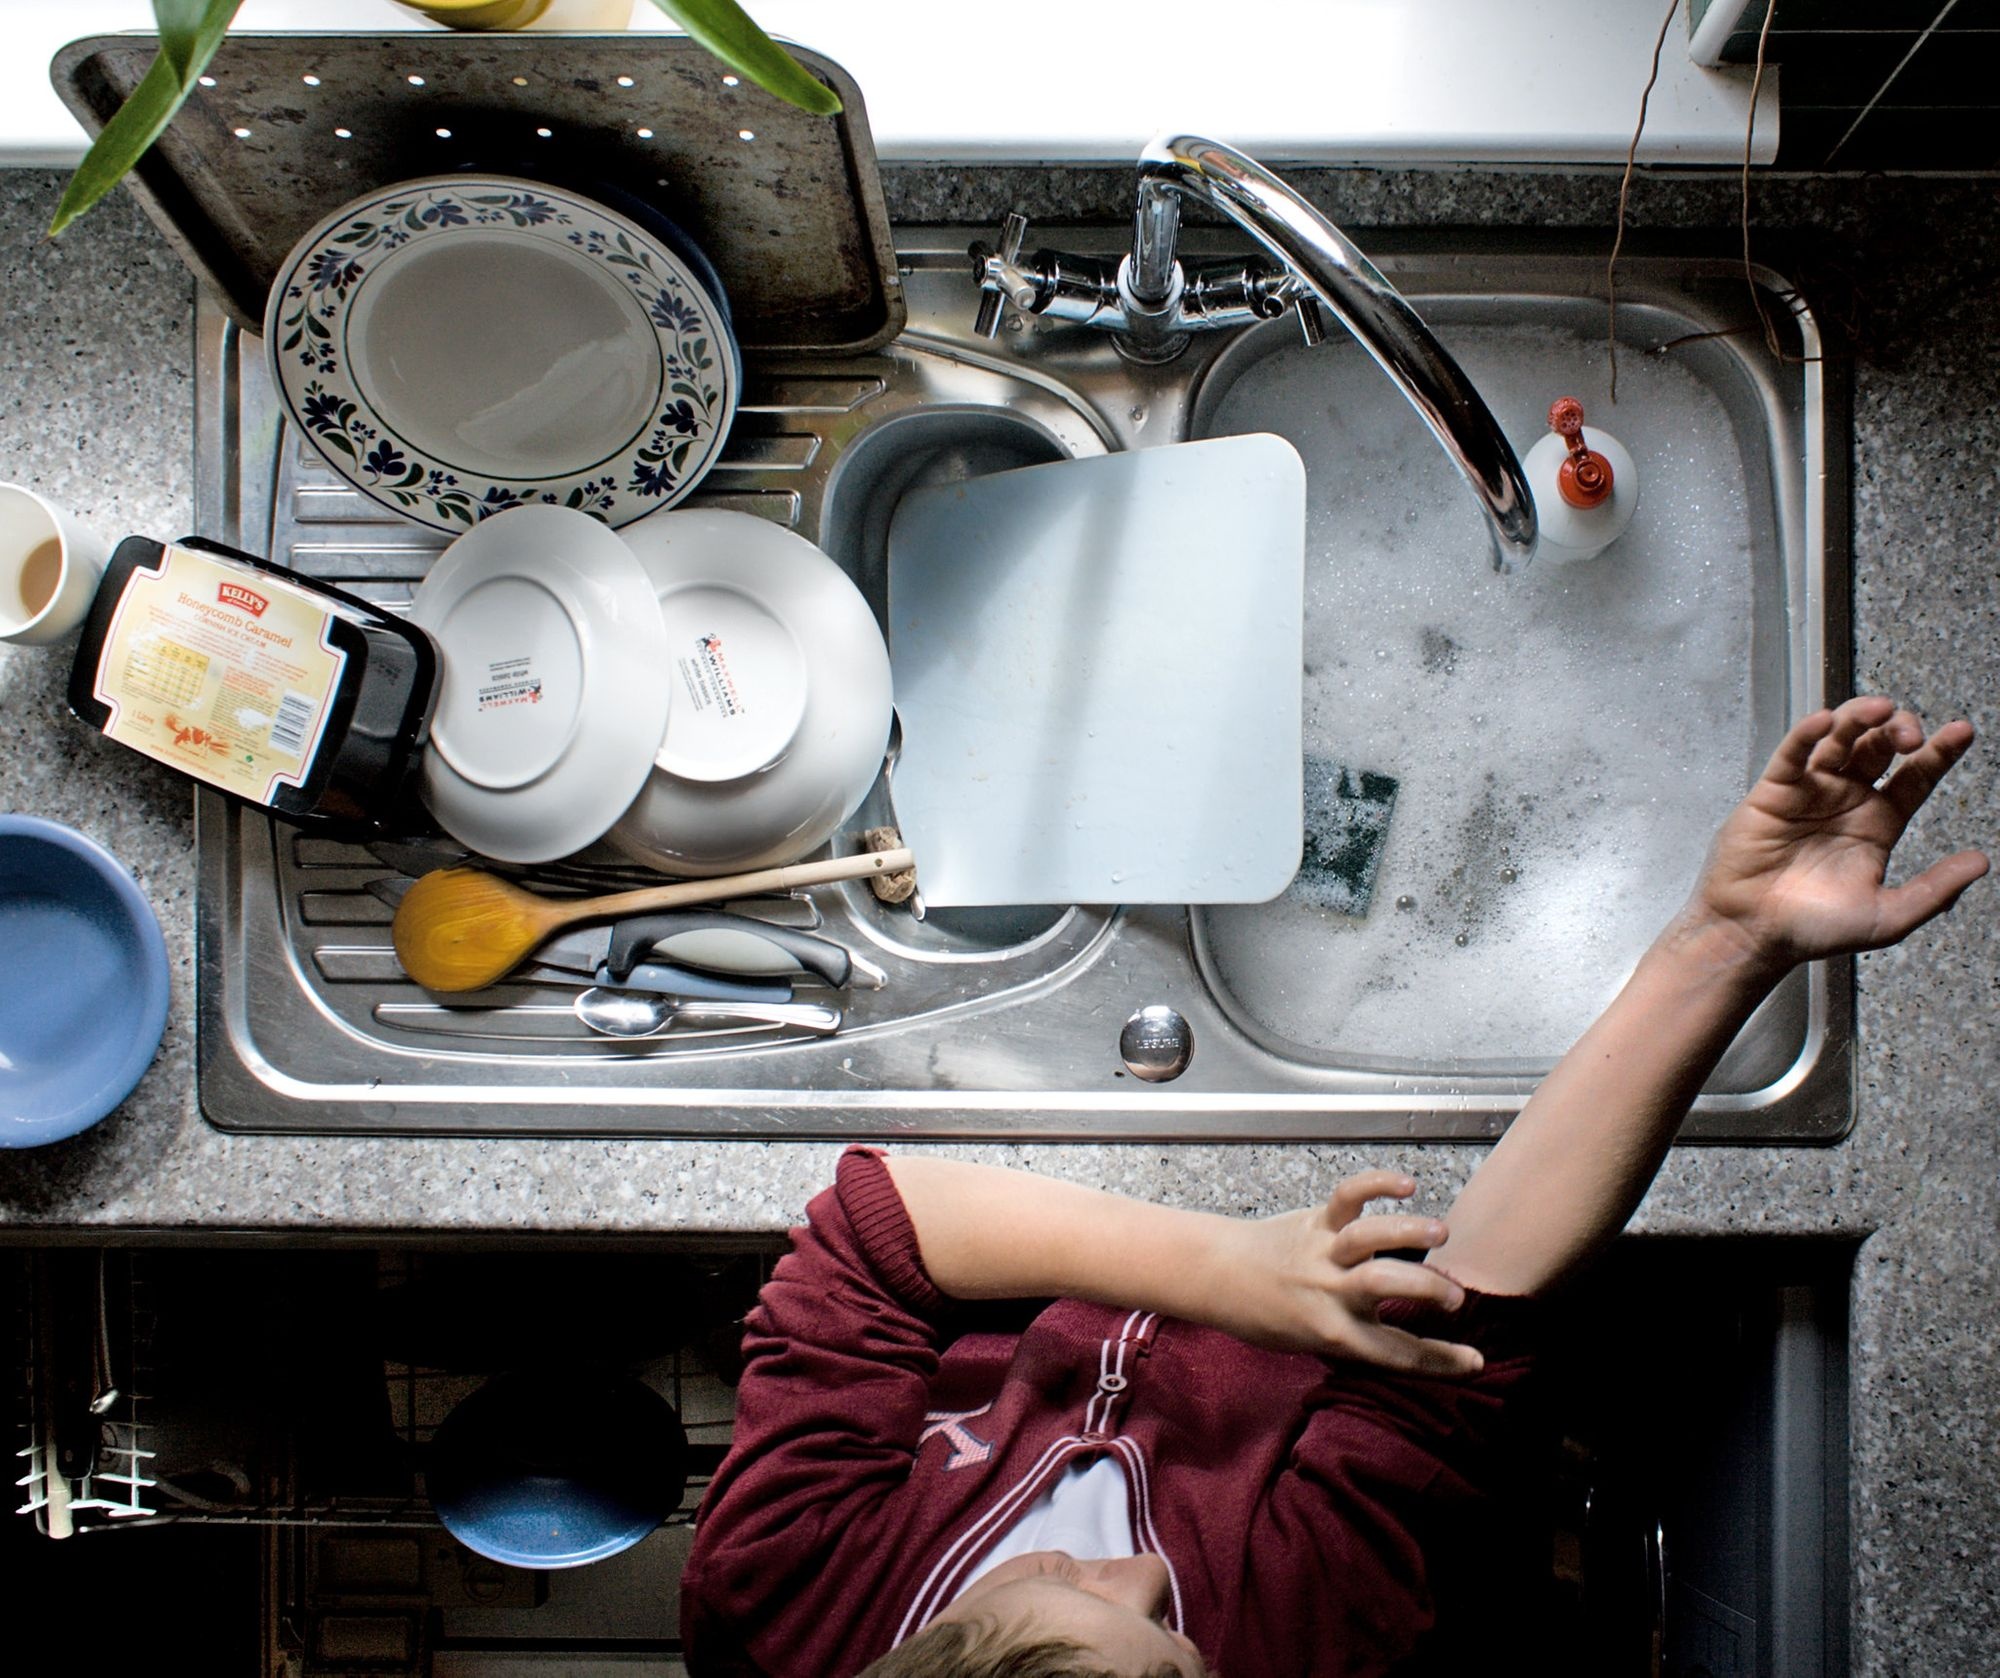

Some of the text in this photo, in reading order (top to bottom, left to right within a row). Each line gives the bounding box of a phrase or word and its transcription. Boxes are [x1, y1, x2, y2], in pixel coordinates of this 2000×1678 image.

[178, 592, 243, 627] Honeycomb
[245, 620, 293, 648] Caramel
[222, 586, 265, 610] KELLY'S
[480, 689, 527, 702] WILLIAMS
[709, 655, 735, 715] WILLIAMS
[717, 652, 740, 711] MAXWELL
